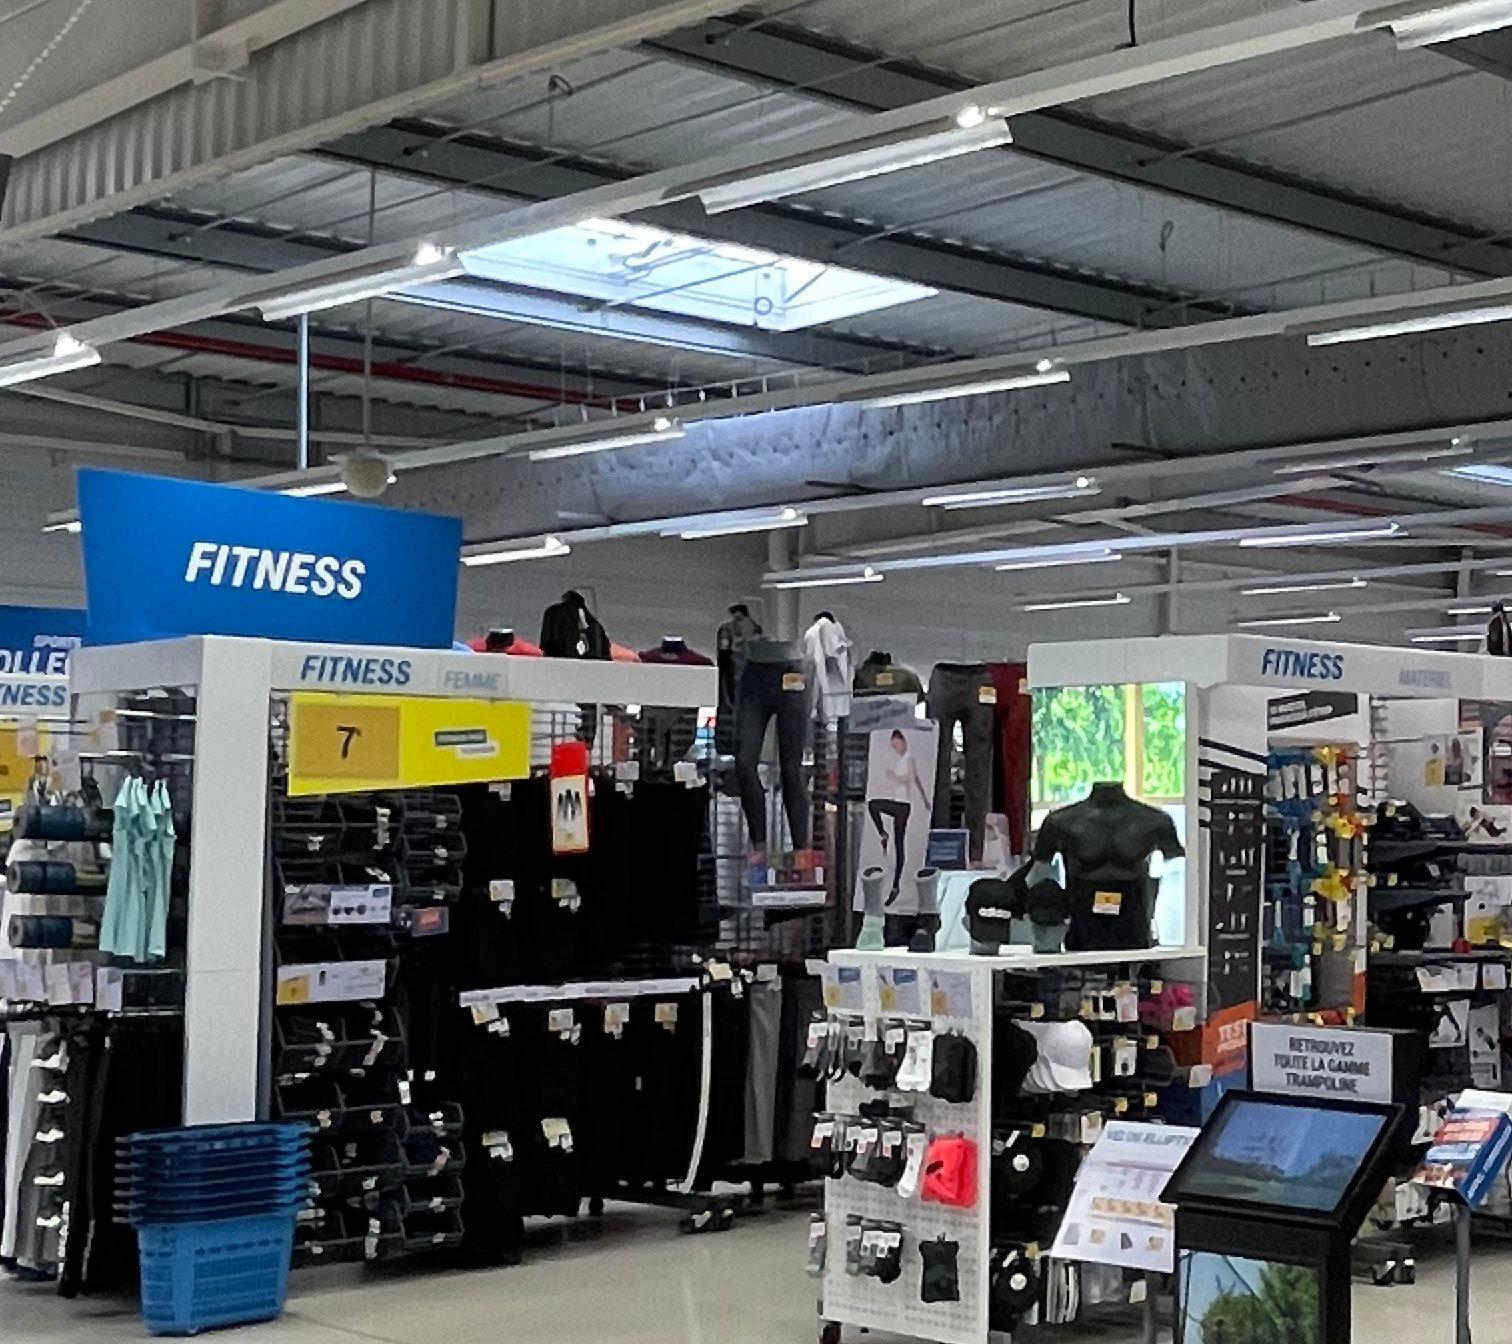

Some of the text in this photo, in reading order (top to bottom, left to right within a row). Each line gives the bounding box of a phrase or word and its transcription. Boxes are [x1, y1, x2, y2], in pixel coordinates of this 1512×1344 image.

[185, 542, 367, 599] FITNESS
[300, 656, 412, 685] FITNESS
[1262, 649, 1344, 680] FITNESS
[336, 726, 362, 759] 7
[1289, 1037, 1354, 1056] RETROUVEZ
[1274, 1053, 1370, 1077] TOUTE LA GAMME
[1285, 1073, 1359, 1094] TRAMPOLINE
